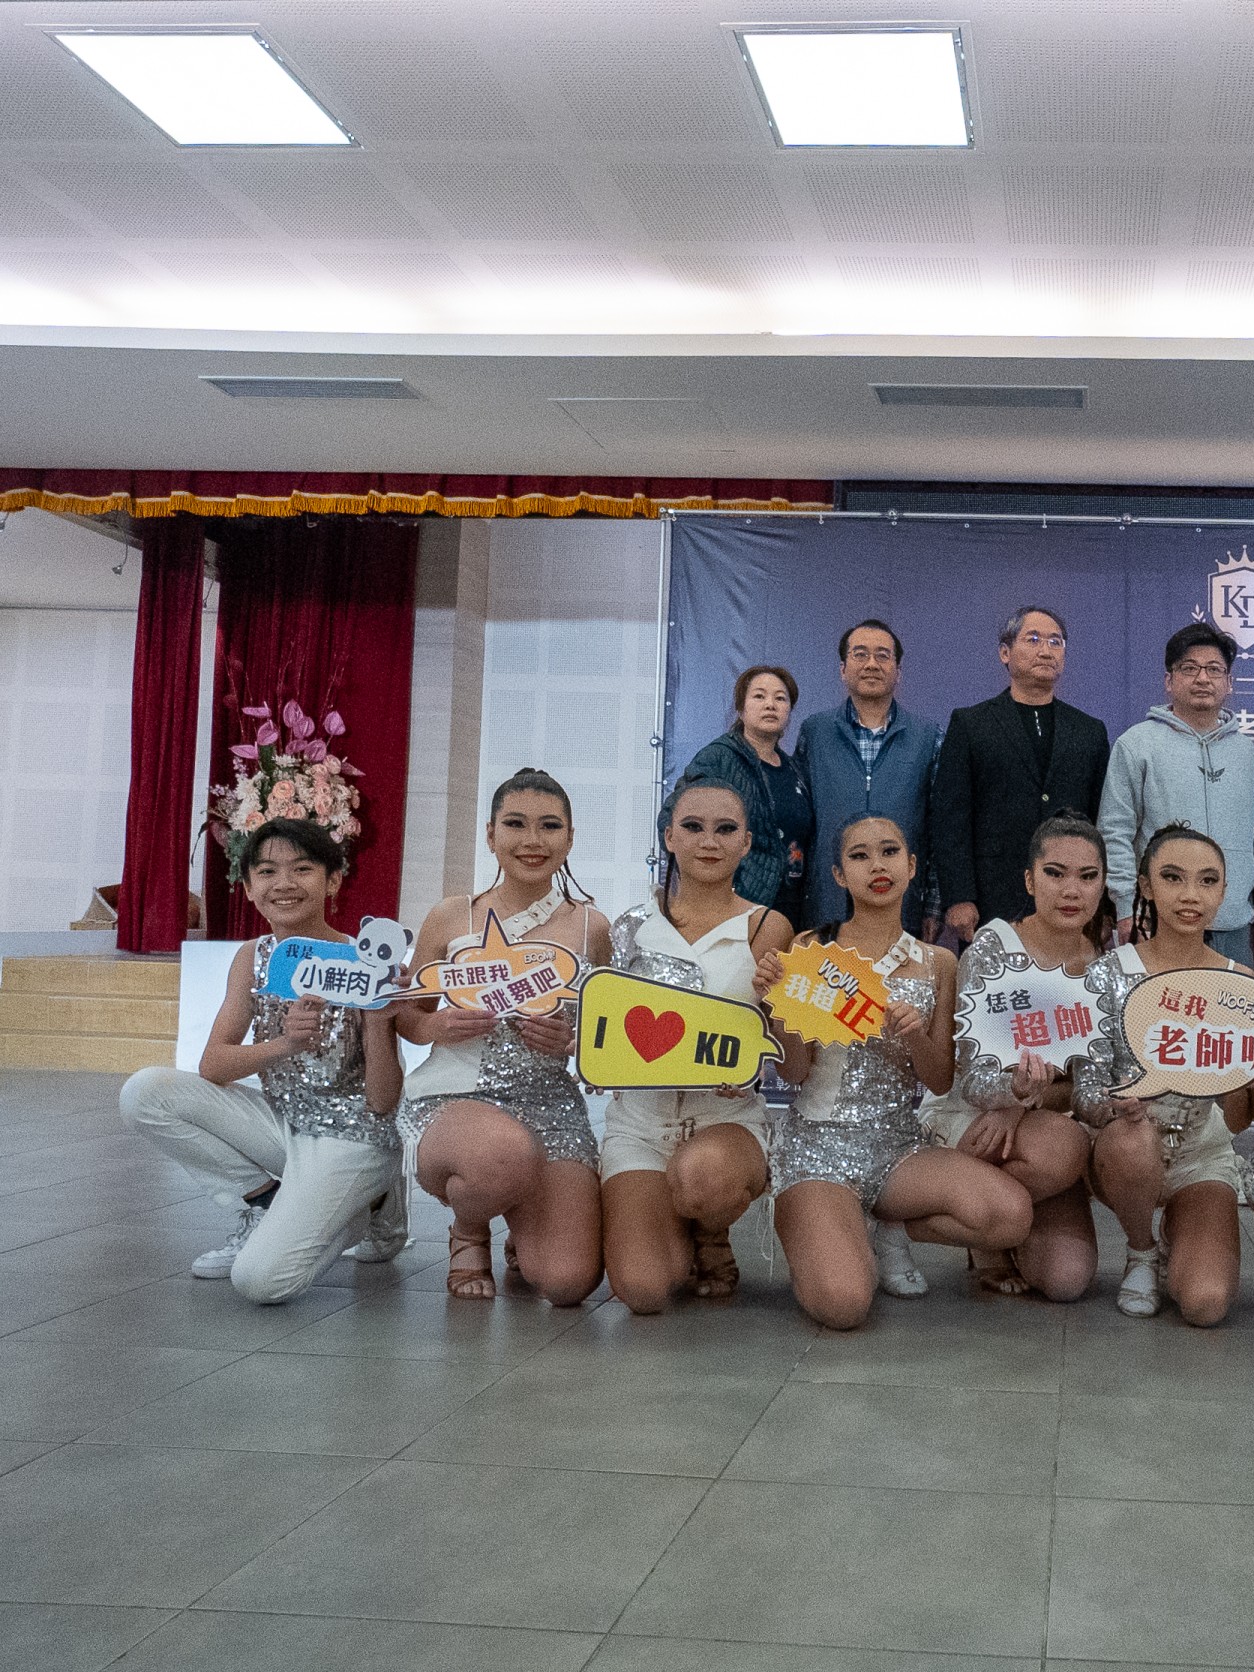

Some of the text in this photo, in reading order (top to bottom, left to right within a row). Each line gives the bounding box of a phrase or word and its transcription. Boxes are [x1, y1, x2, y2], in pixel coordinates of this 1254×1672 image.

[285, 943, 314, 960] 我是
[299, 964, 371, 996] 小鮮肉
[443, 964, 510, 987] 來跟我
[481, 966, 562, 1014] 跳舞吧
[818, 958, 859, 1000] WOW!
[1158, 987, 1208, 1020] 這我
[593, 1016, 741, 1068] I KD
[1010, 1002, 1093, 1050] 超帥
